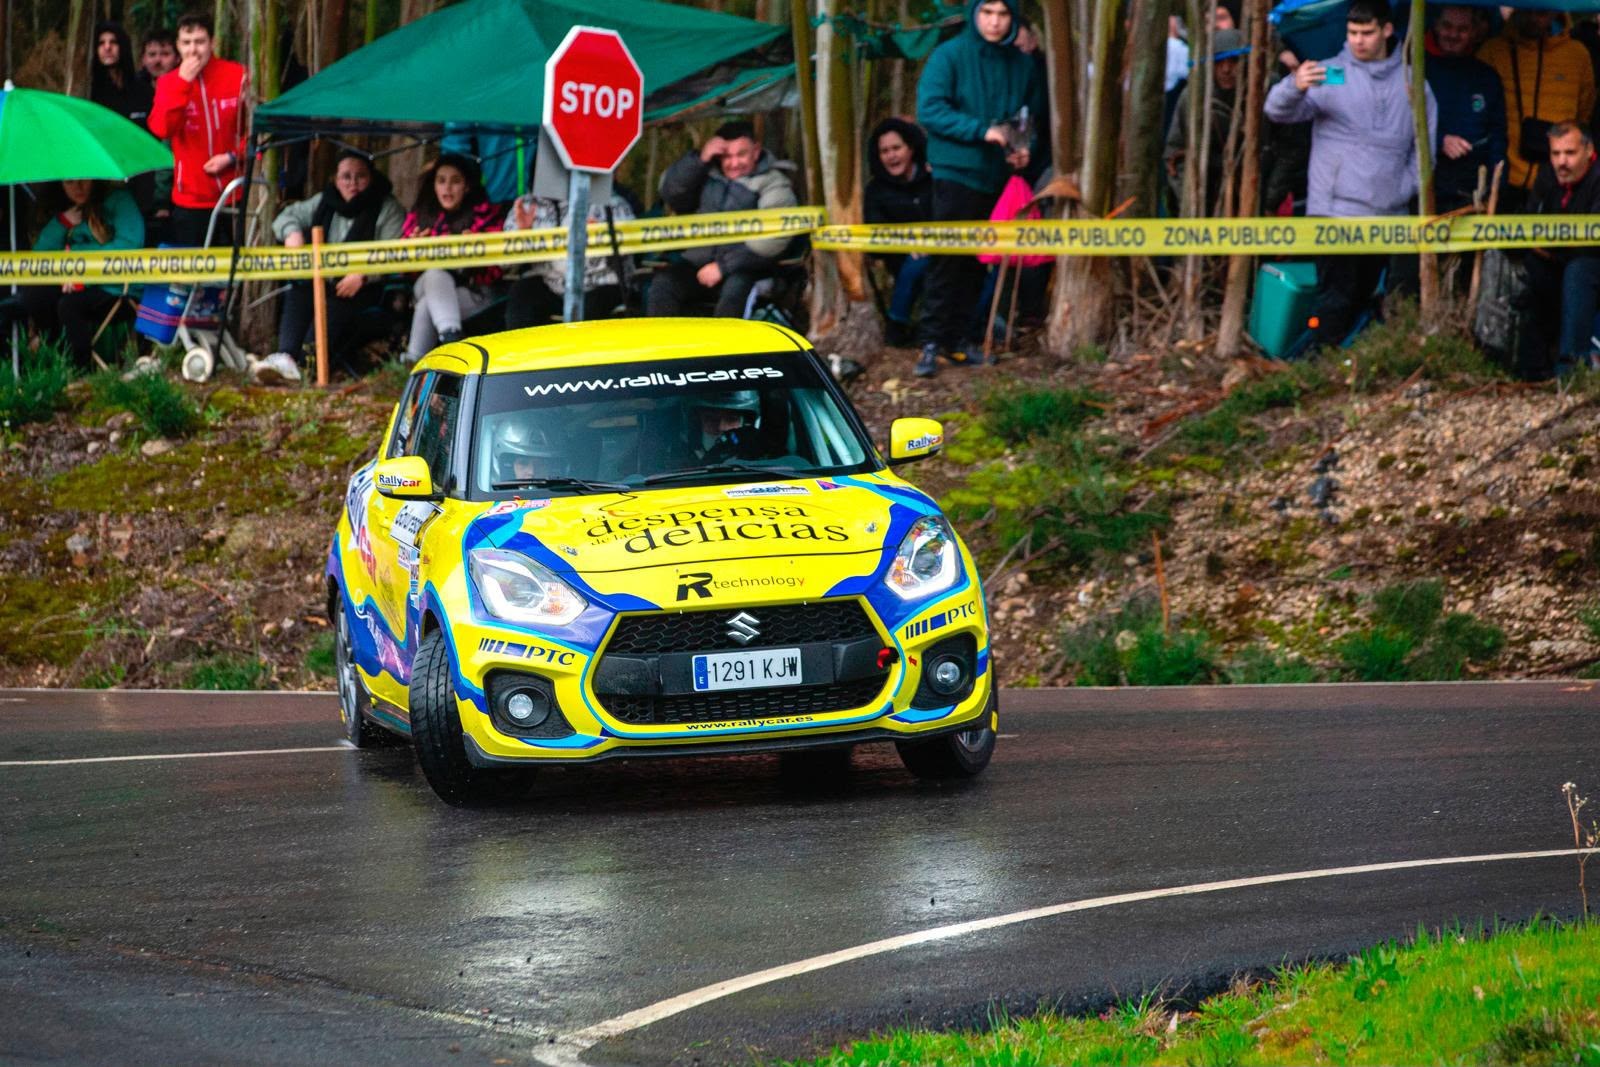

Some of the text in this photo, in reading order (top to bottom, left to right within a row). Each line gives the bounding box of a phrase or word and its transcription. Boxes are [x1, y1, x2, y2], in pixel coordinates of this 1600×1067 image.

[560, 80, 634, 119] STOP
[641, 218, 763, 243] ZONA PUBLICO
[870, 226, 998, 247] ZONA PUBLICO
[1015, 227, 1146, 247] ZONA PUBLICO
[1164, 225, 1296, 246] ZONA PUBLICO
[1315, 224, 1450, 245] ZONA PUBLICO
[1472, 223, 1600, 242] ZONA PUBLIC
[367, 240, 486, 265] ZONA PUBLICO
[503, 236, 547, 255] ZONA
[19, 257, 86, 276] PUBLICO
[102, 254, 216, 275] ZONA PUBLICO
[524, 366, 784, 397] www.rallycar.es
[379, 474, 421, 488] Rallycar
[587, 505, 810, 537] despensa
[624, 517, 850, 553] delicias
[713, 575, 806, 589] technology
[948, 600, 977, 624] PTC
[526, 645, 575, 666] PTC
[699, 656, 798, 684] E 1291 KJW
[686, 714, 814, 730] www.rallycar.es
